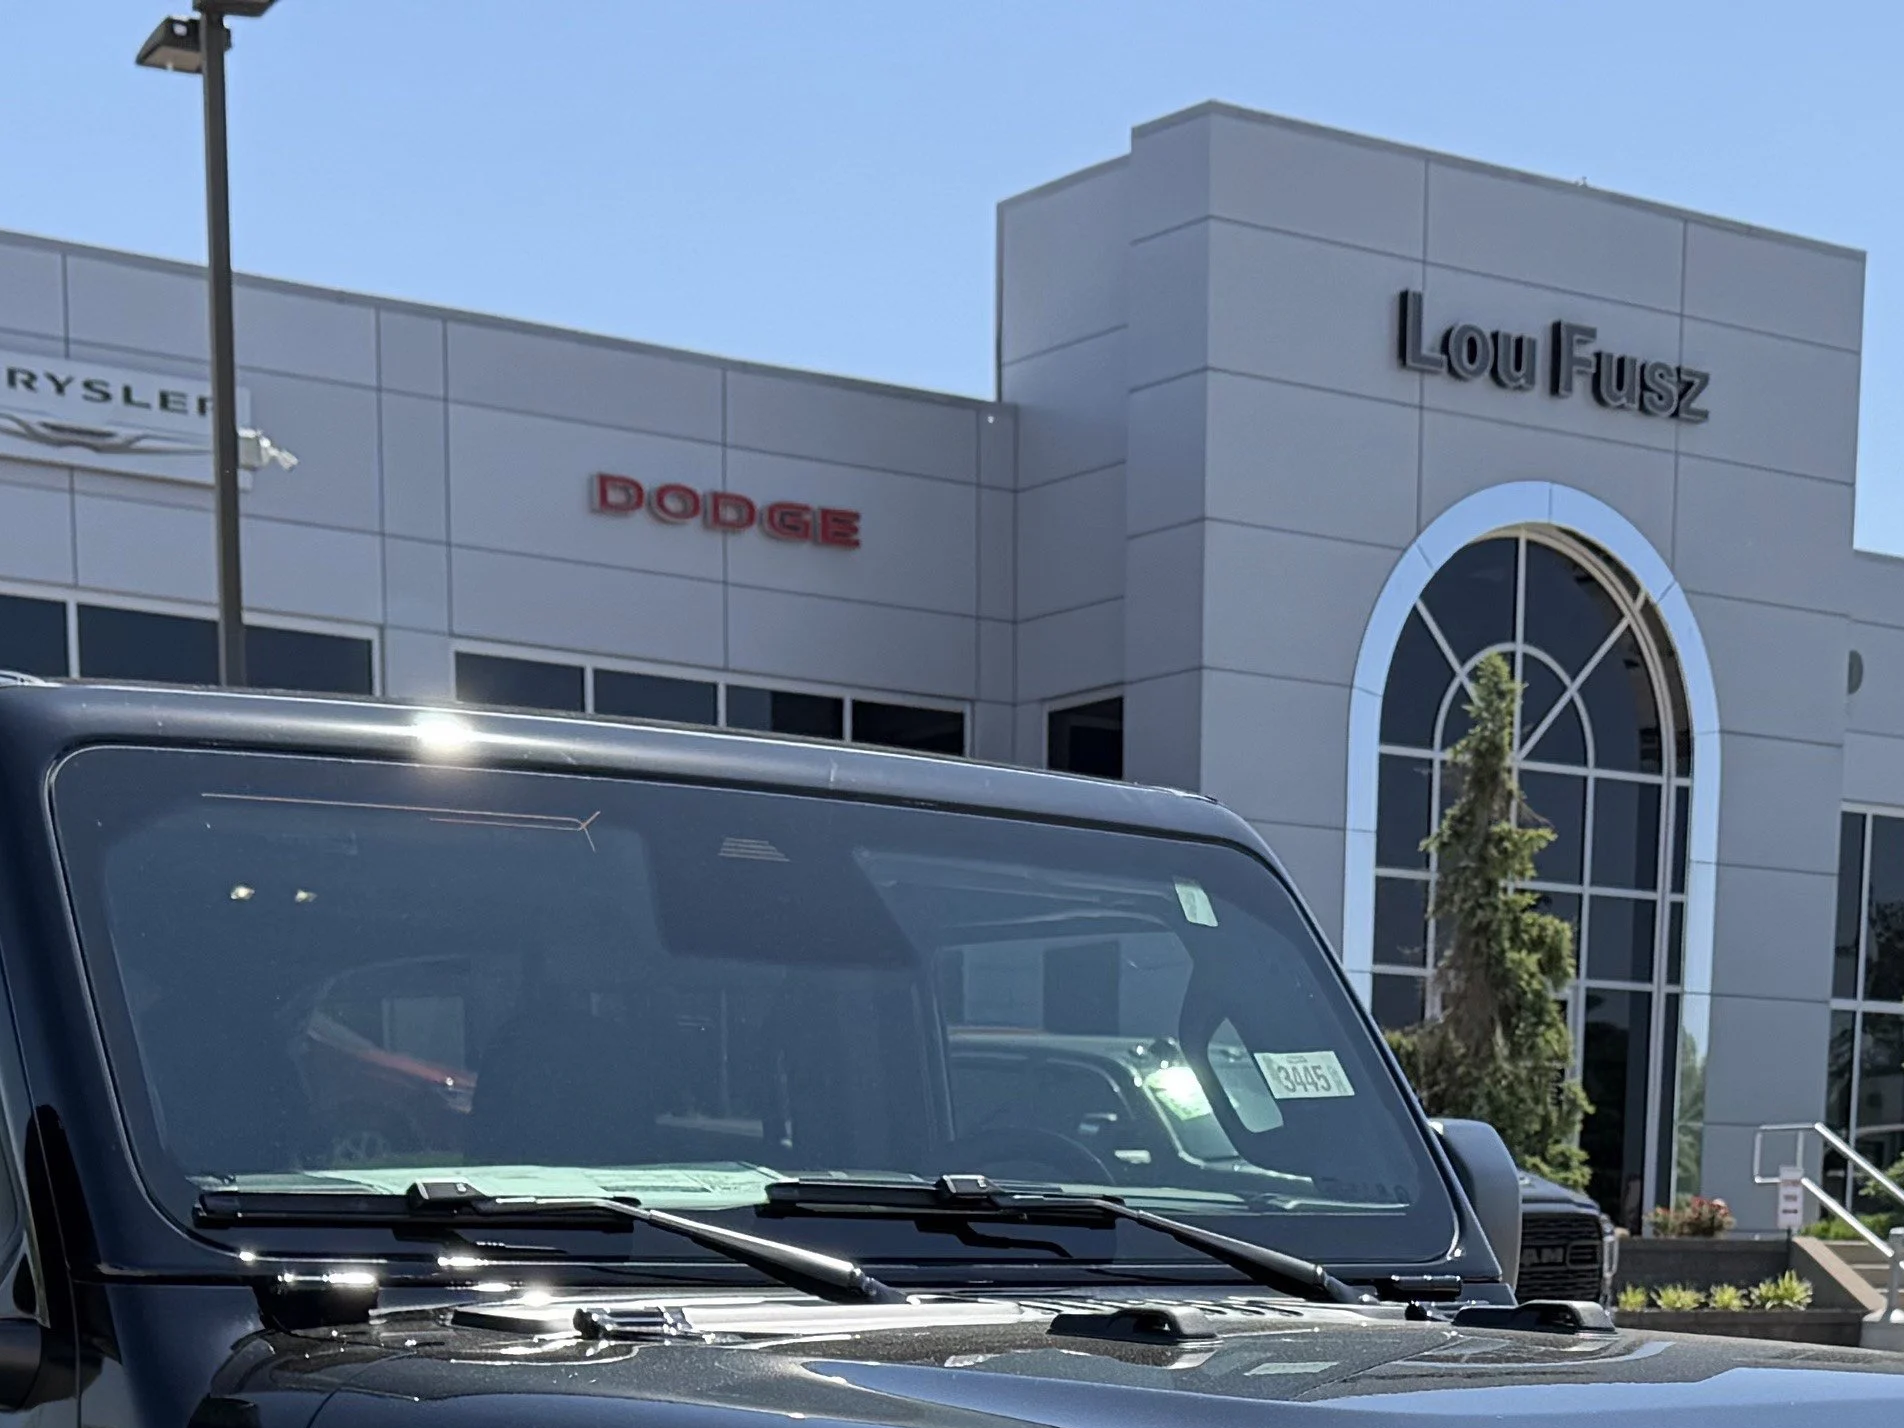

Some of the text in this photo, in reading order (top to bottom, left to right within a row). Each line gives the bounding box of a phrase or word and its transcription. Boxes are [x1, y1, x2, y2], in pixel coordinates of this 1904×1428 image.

[1397, 288, 1711, 424] Lou Fusz
[590, 471, 862, 550] DODGE
[1276, 1064, 1332, 1093] 3445
[1520, 1247, 1565, 1265] AM
